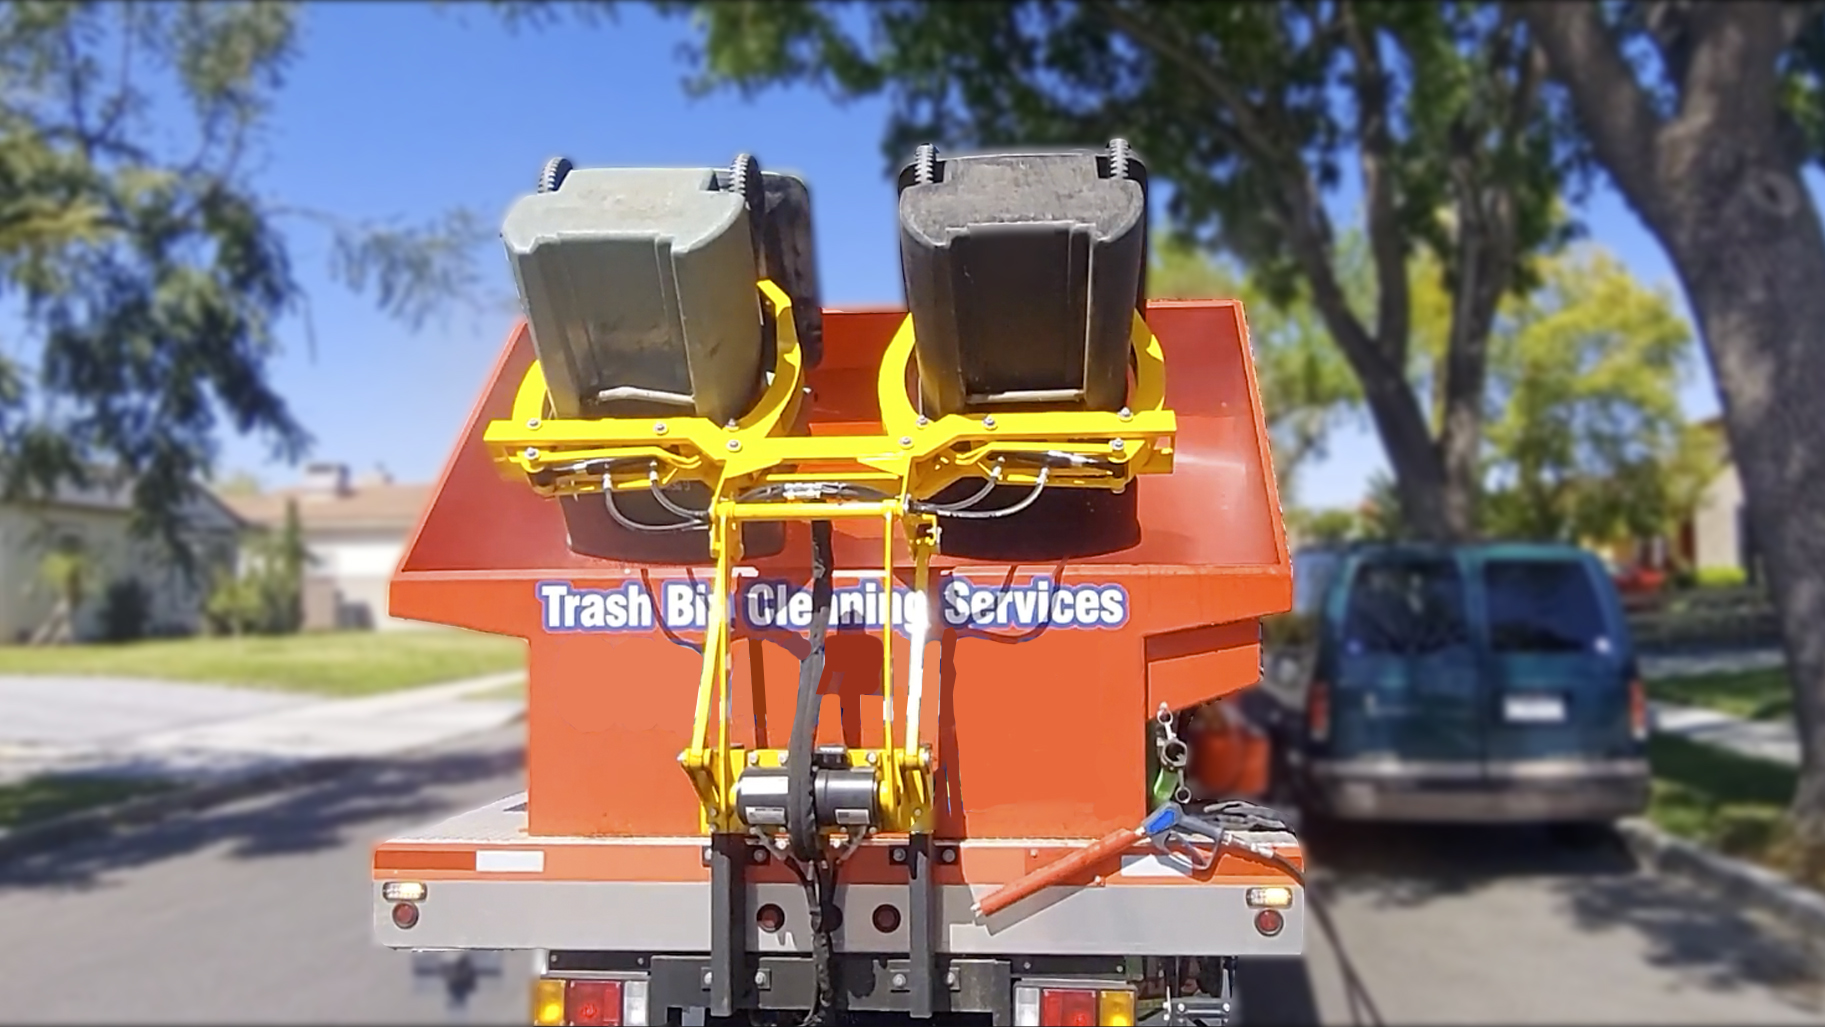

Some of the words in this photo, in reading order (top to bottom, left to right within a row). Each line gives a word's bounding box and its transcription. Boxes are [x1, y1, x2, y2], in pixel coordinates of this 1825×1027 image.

[542, 584, 653, 628] Trash
[667, 583, 731, 627] Bi
[944, 580, 1124, 625] Services
